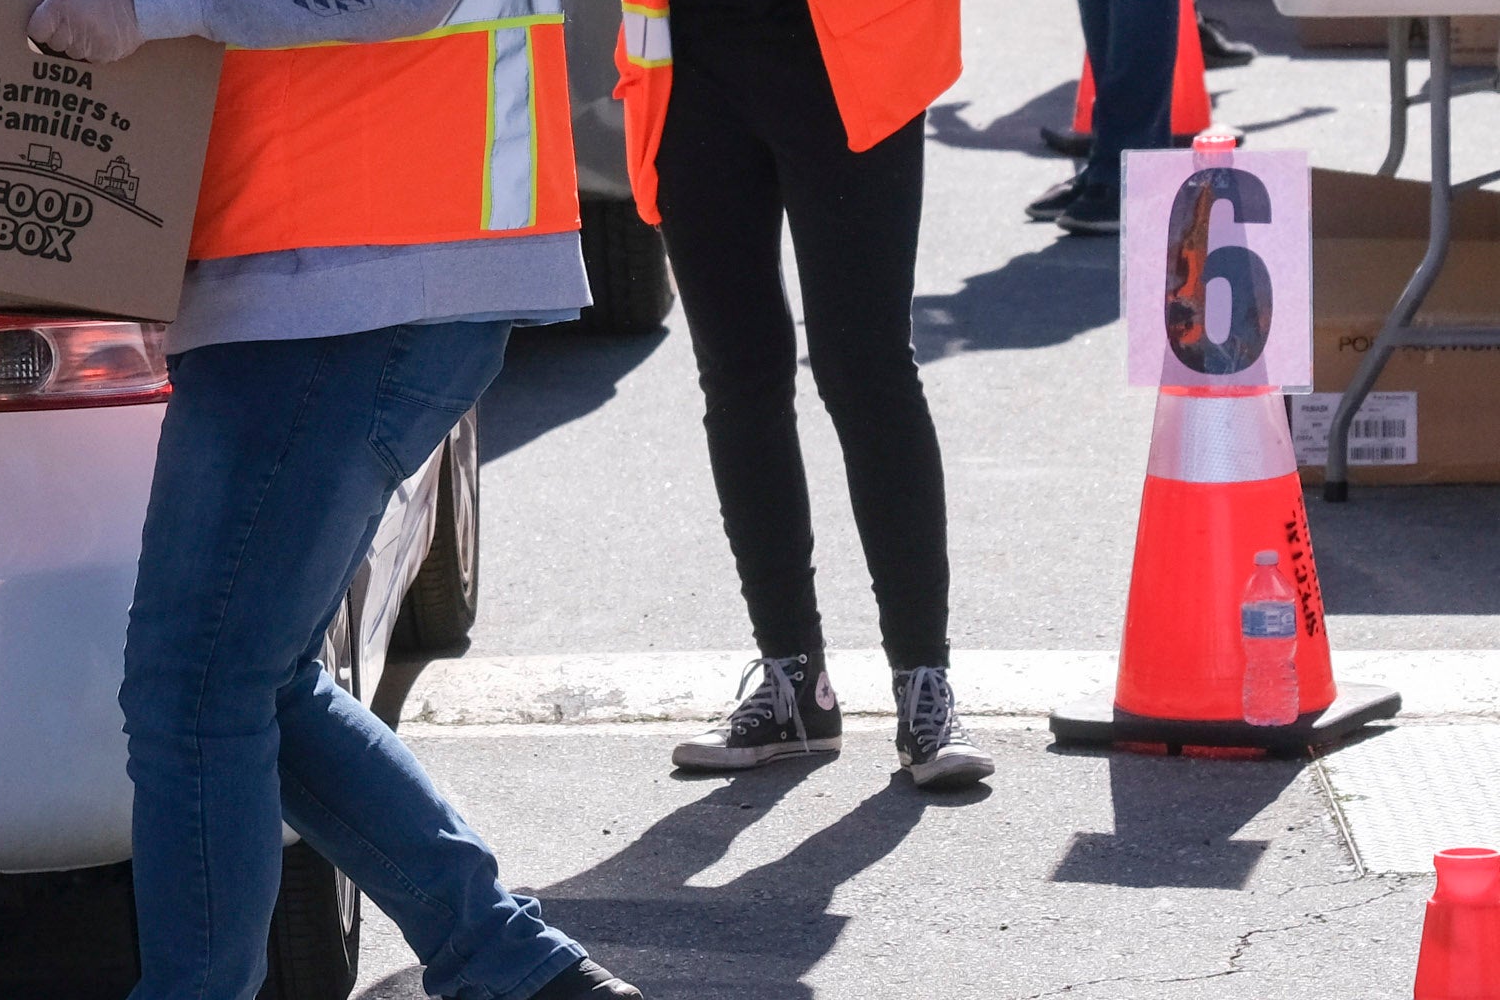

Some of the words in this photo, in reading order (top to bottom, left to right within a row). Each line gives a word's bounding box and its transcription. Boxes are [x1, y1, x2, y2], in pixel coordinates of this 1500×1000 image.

[32, 61, 93, 91] USDA
[110, 111, 131, 132] to
[1164, 167, 1274, 375] 6
